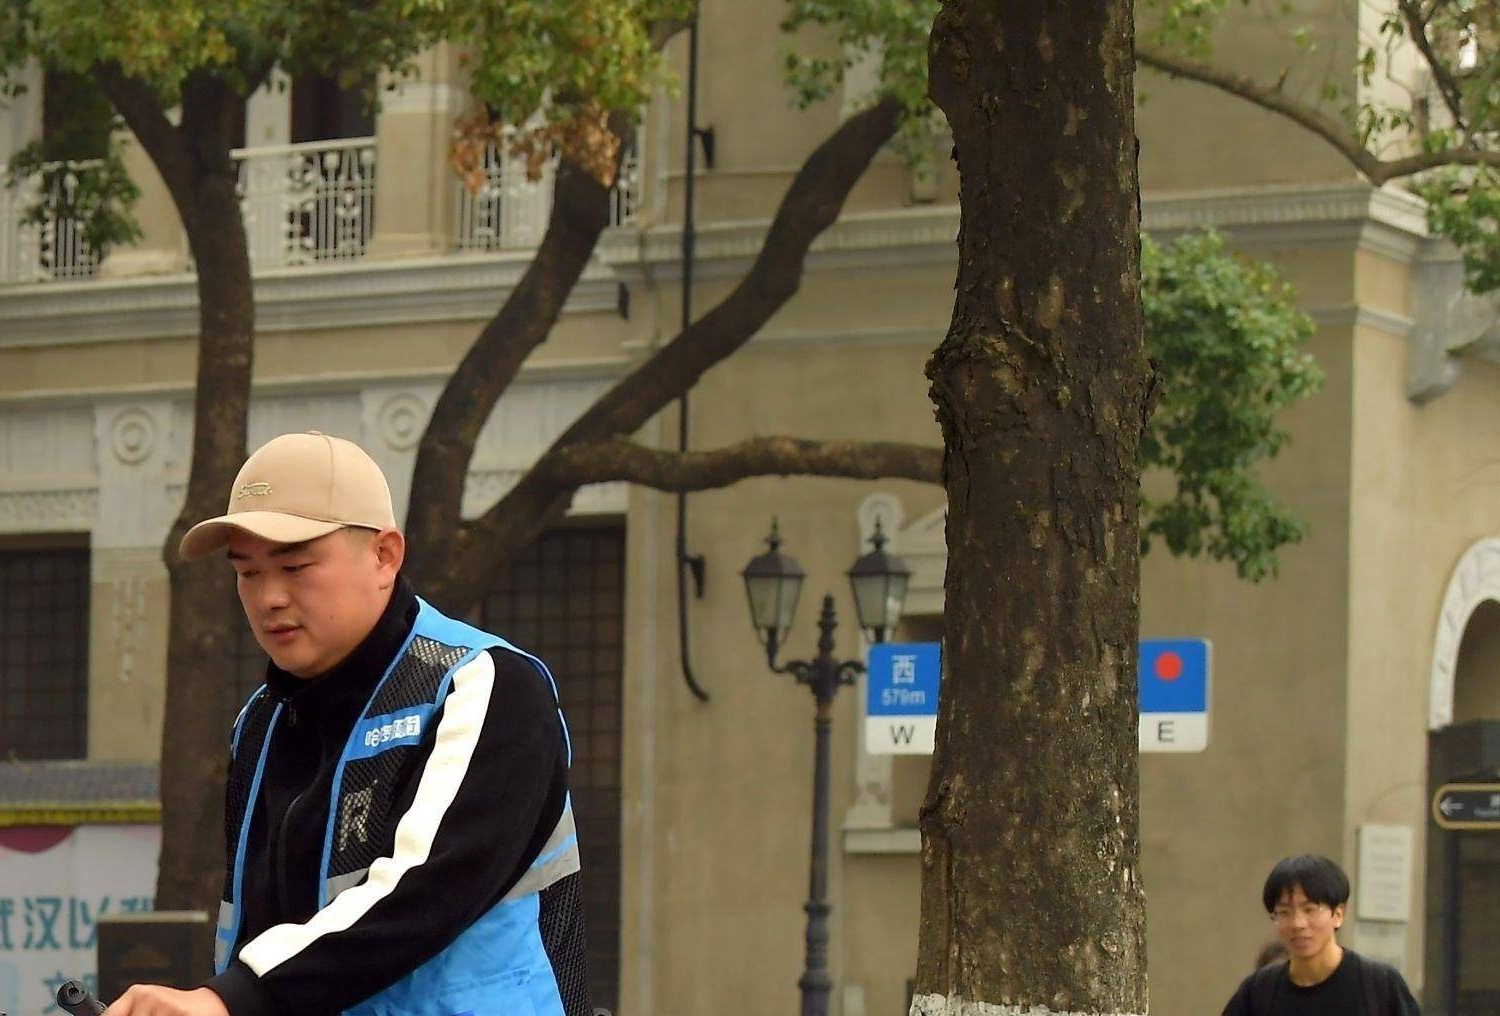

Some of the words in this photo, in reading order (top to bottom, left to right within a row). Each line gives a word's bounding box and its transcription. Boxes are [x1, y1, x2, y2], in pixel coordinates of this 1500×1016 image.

[891, 654, 917, 684] 西
[890, 725, 915, 745] W
[1158, 721, 1174, 743] E
